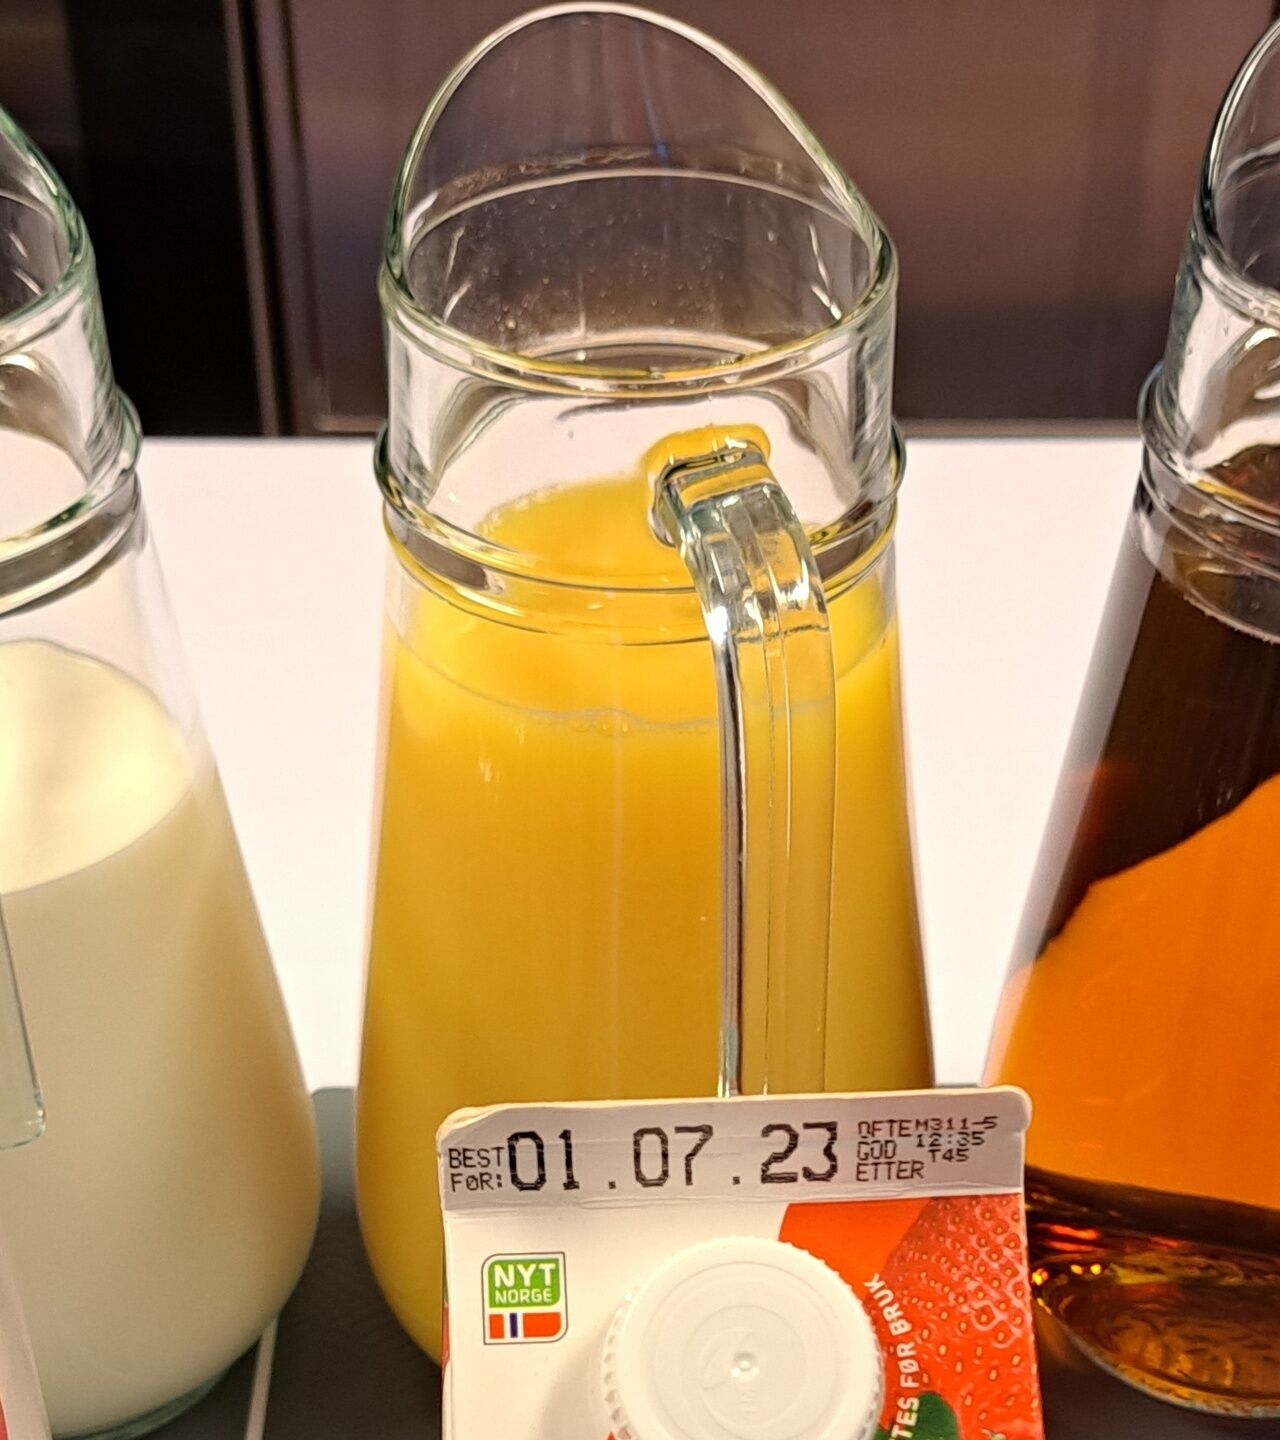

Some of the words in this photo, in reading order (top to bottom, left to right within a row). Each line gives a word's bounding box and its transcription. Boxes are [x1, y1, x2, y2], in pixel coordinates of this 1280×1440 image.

[448, 1146, 505, 1169] BEST
[857, 1139, 897, 1161] GOD
[928, 1149, 970, 1163] T45
[856, 1160, 925, 1182] ETTER
[493, 1263, 556, 1287] NYT
[494, 1288, 553, 1304] NORGE
[864, 1273, 912, 1336] BRUK
